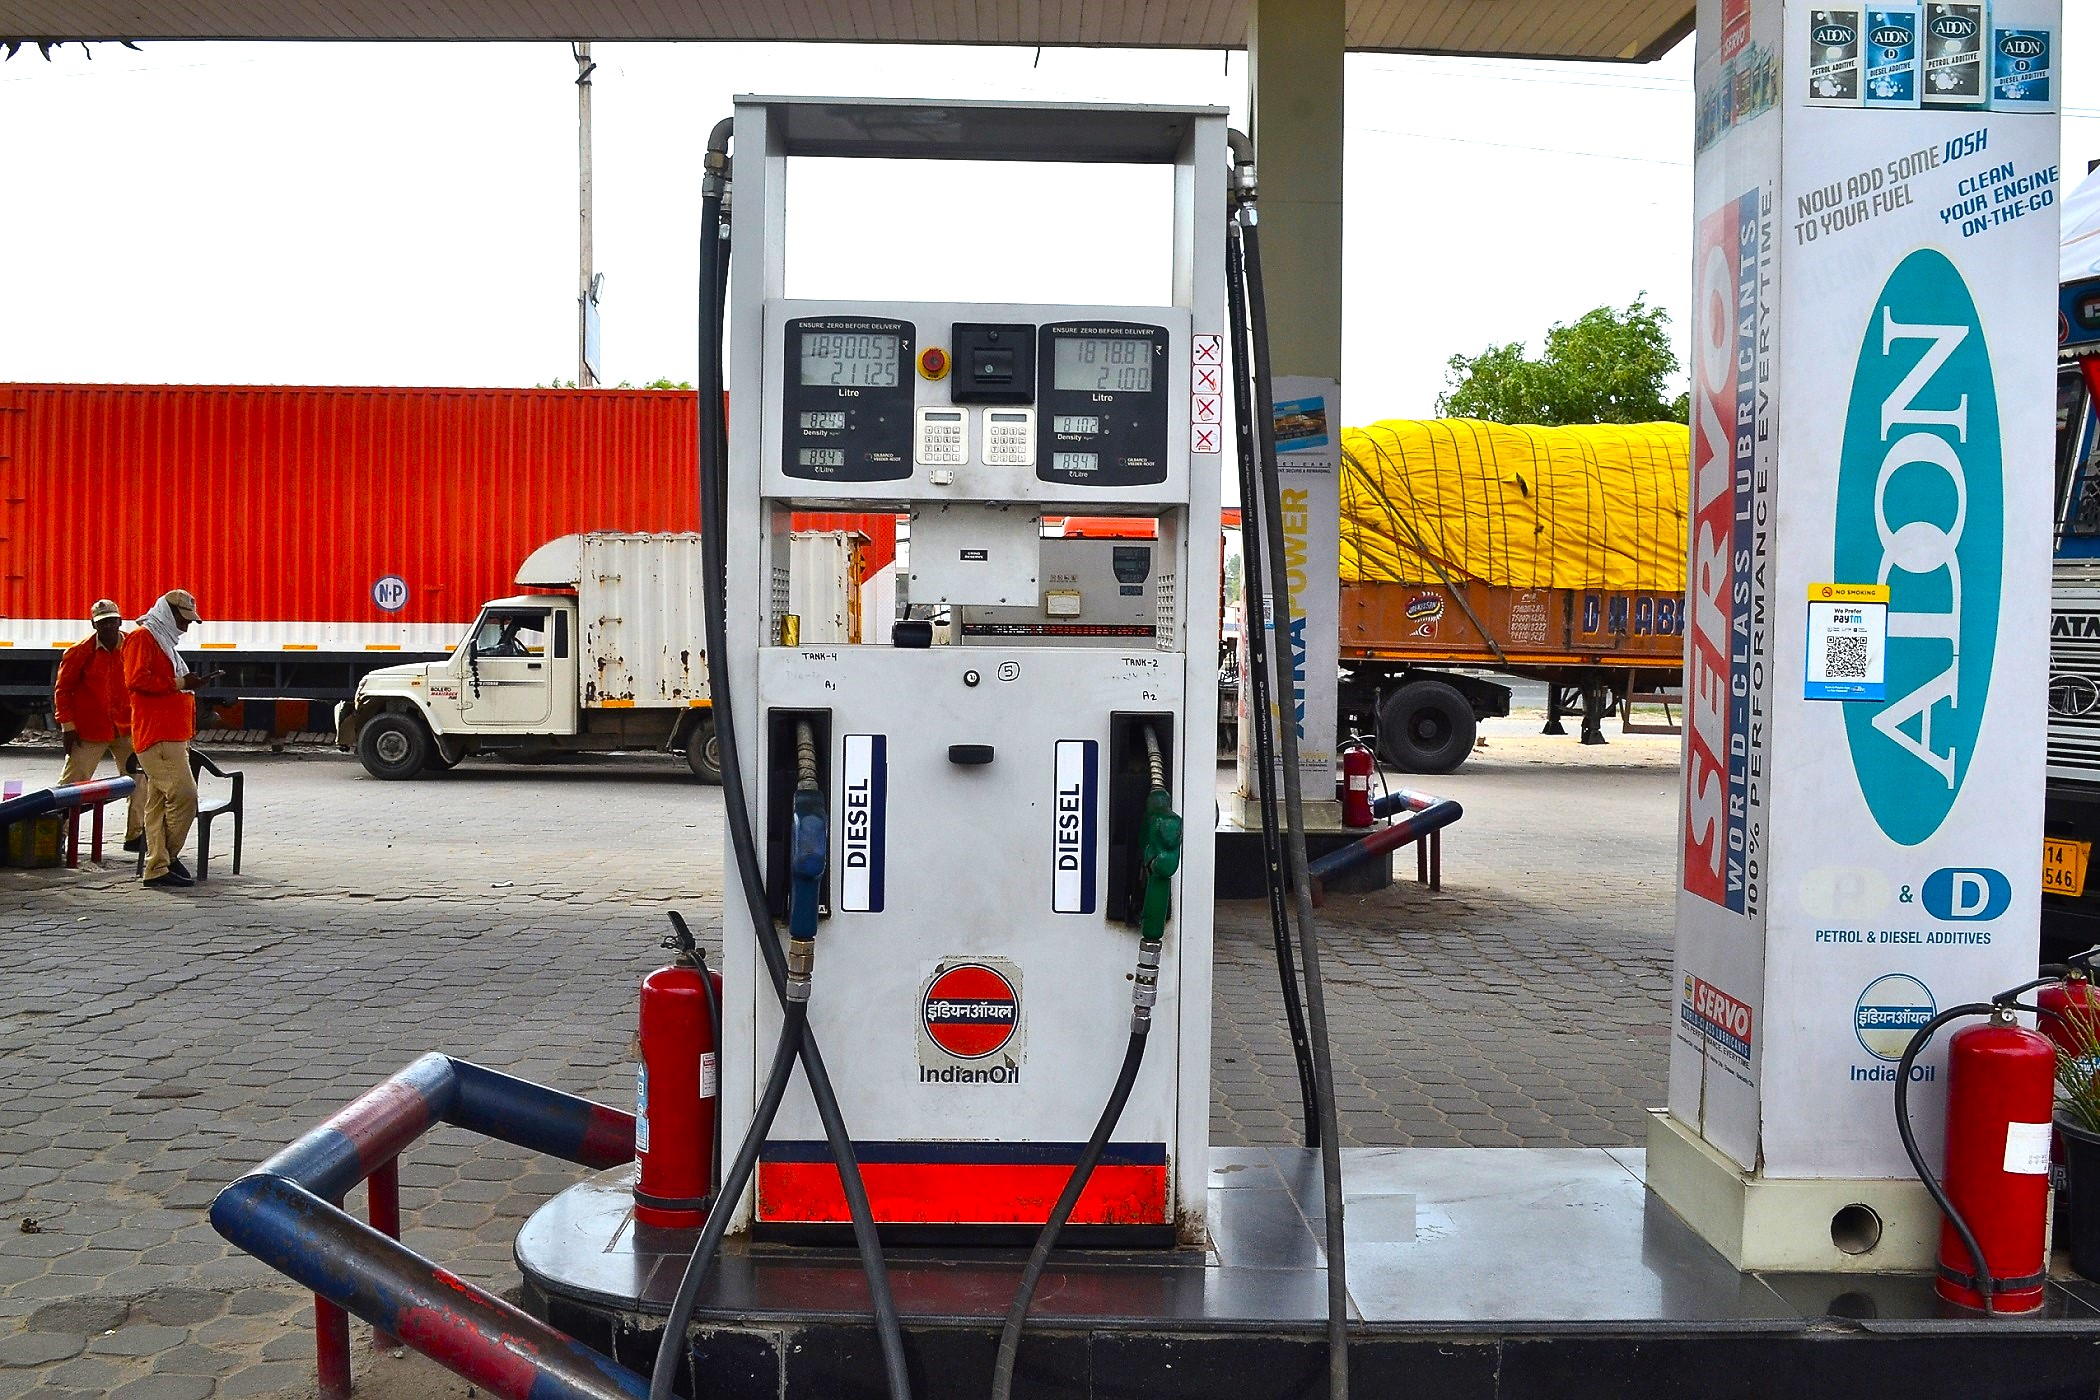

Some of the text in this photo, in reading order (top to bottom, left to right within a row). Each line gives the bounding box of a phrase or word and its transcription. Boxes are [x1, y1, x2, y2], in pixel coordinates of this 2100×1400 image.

[1816, 29, 1851, 42] ADON
[1874, 30, 1909, 43] ADON
[1935, 21, 1972, 34] ADON
[2004, 41, 2041, 56] ADON
[1812, 59, 1855, 76] PETROL ADDITIVE
[1870, 61, 1911, 77] DIESEL ADDITIVE
[1928, 52, 1978, 68] PETROL ADDITIVE
[1999, 70, 2046, 85] DIESEL ADDITIVE
[1797, 127, 1988, 219] NOW ADD SOME JOSH
[1958, 161, 2015, 197] CLEAN
[1939, 165, 2059, 225] YOUR ENGINE
[1794, 183, 1914, 246] TO YOUR FUEL
[1962, 189, 2054, 238] ON-THE-GO
[830, 362, 895, 385] 211.25
[838, 388, 859, 397] Litre
[1092, 393, 1113, 402] Litre
[803, 429, 828, 437] Density
[1057, 433, 1082, 442] Density
[1727, 218, 1757, 892] WORLD-CLASS LUBRICANTS
[1747, 179, 1772, 921] 100% PERFORMANCE. EVERYTIME.
[1871, 305, 1969, 790] ADON
[1690, 245, 1734, 878] SERVO
[2051, 615, 2100, 637] ATA
[801, 652, 838, 662] TANK-4
[1121, 657, 1159, 668] TANK-2
[847, 778, 868, 868] DIESEL
[1058, 783, 1080, 871] DIESEL
[2047, 846, 2063, 864] 14
[1899, 885, 1914, 903] &
[1951, 872, 1990, 917] D
[1815, 930, 1992, 945] PETROL & DIESEL ADDITIVES
[927, 1001, 1013, 1021] इंडियनऑयल
[1696, 984, 1749, 1037] SERVO
[919, 1065, 1020, 1084] IndianOil
[1850, 1064, 1935, 1082] IndiaOil
